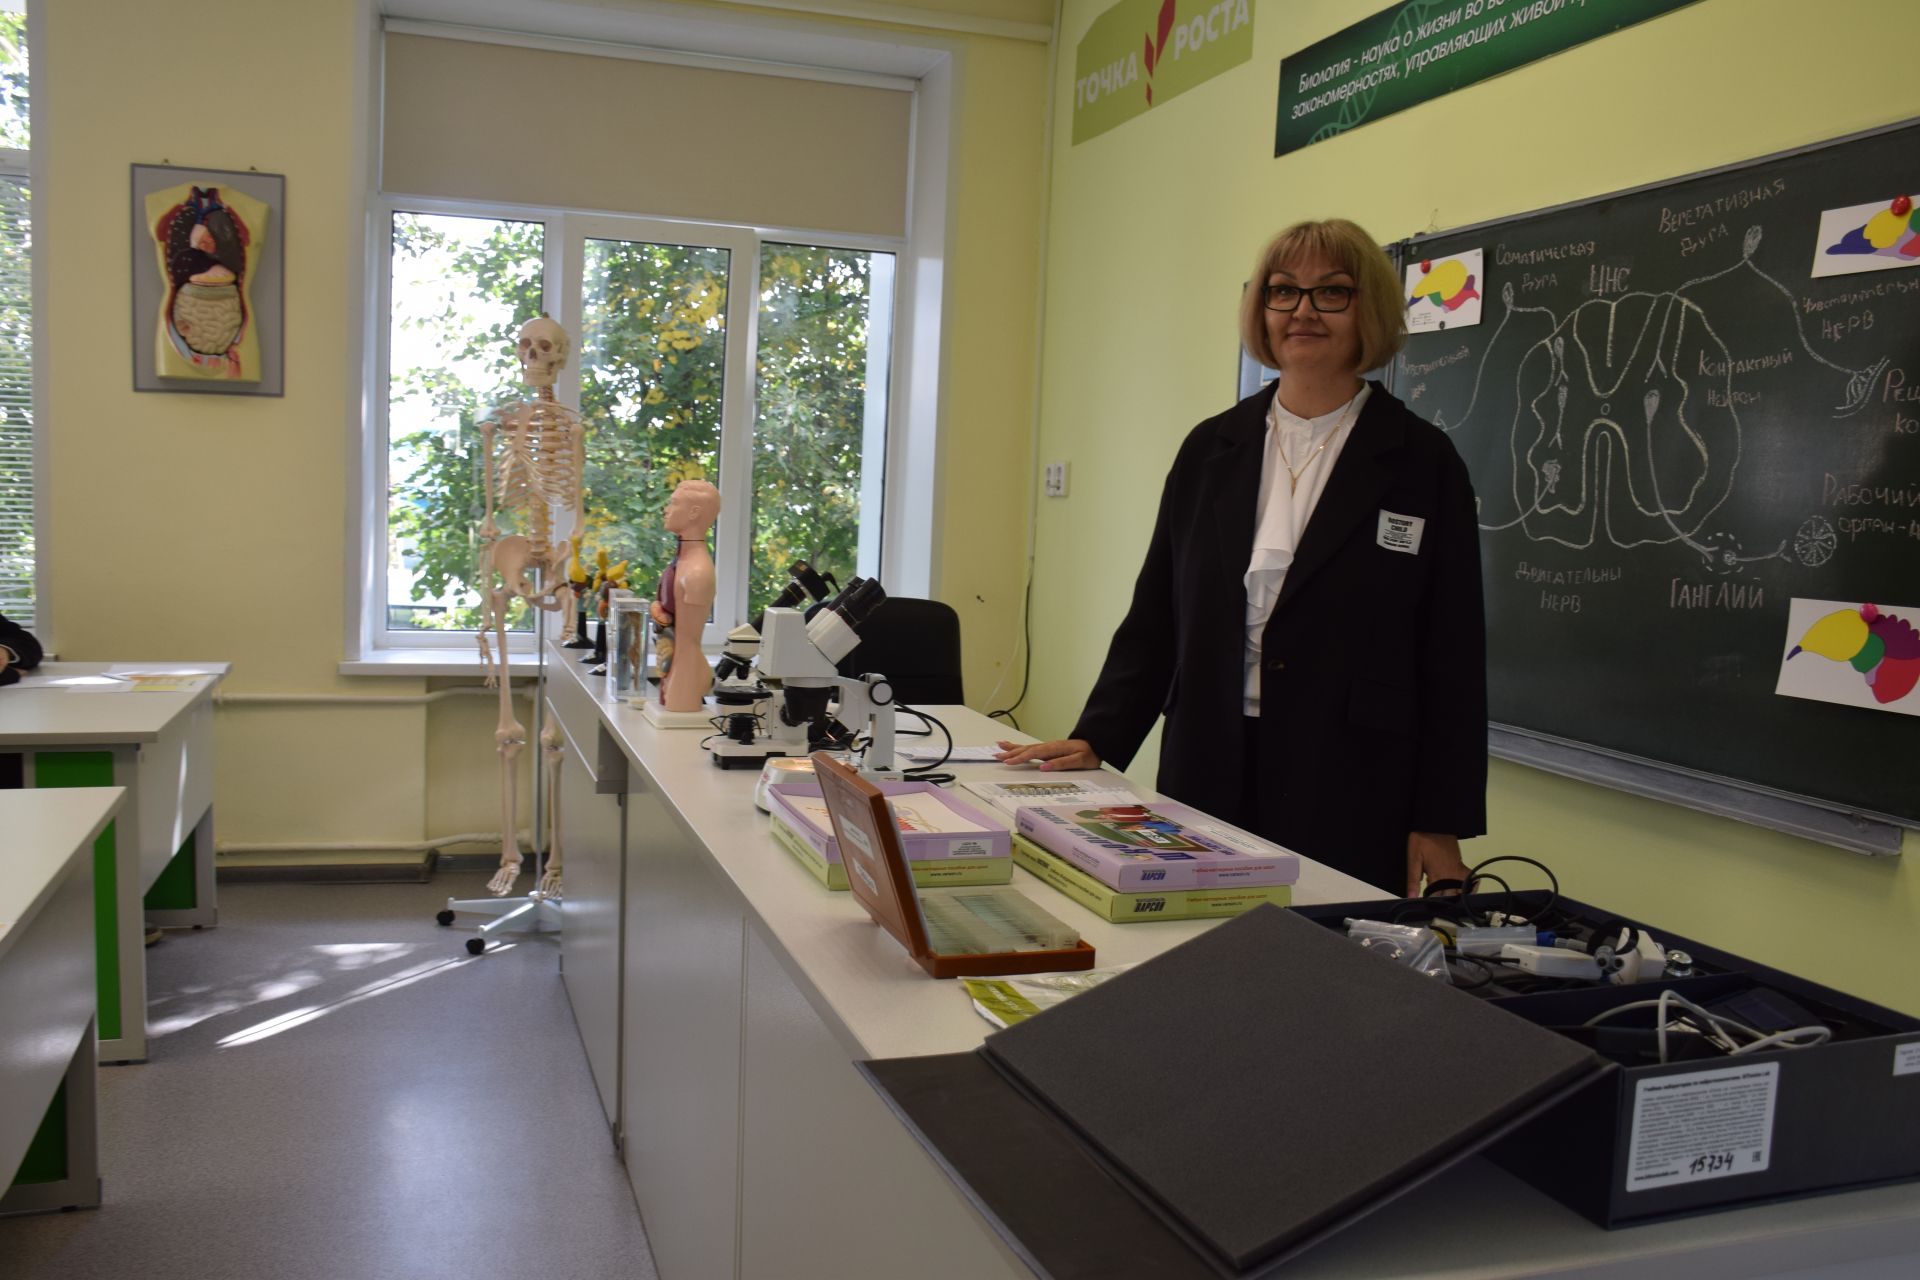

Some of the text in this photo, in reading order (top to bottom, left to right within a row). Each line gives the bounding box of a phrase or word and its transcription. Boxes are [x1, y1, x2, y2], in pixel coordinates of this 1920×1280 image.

[1076, 1, 1250, 110] ТОЧКА РОСТА
[1291, 62, 1401, 121] закономерностях,
[1404, 15, 1506, 79] управляющих
[1298, 59, 1352, 94] Биология
[1361, 35, 1401, 67] наука
[1403, 31, 1413, 47] о
[1416, 3, 1462, 40] жизни
[1465, 0, 1484, 18] во
[1590, 264, 1631, 296] ЦНС
[1689, 1151, 1735, 1175] 15734
